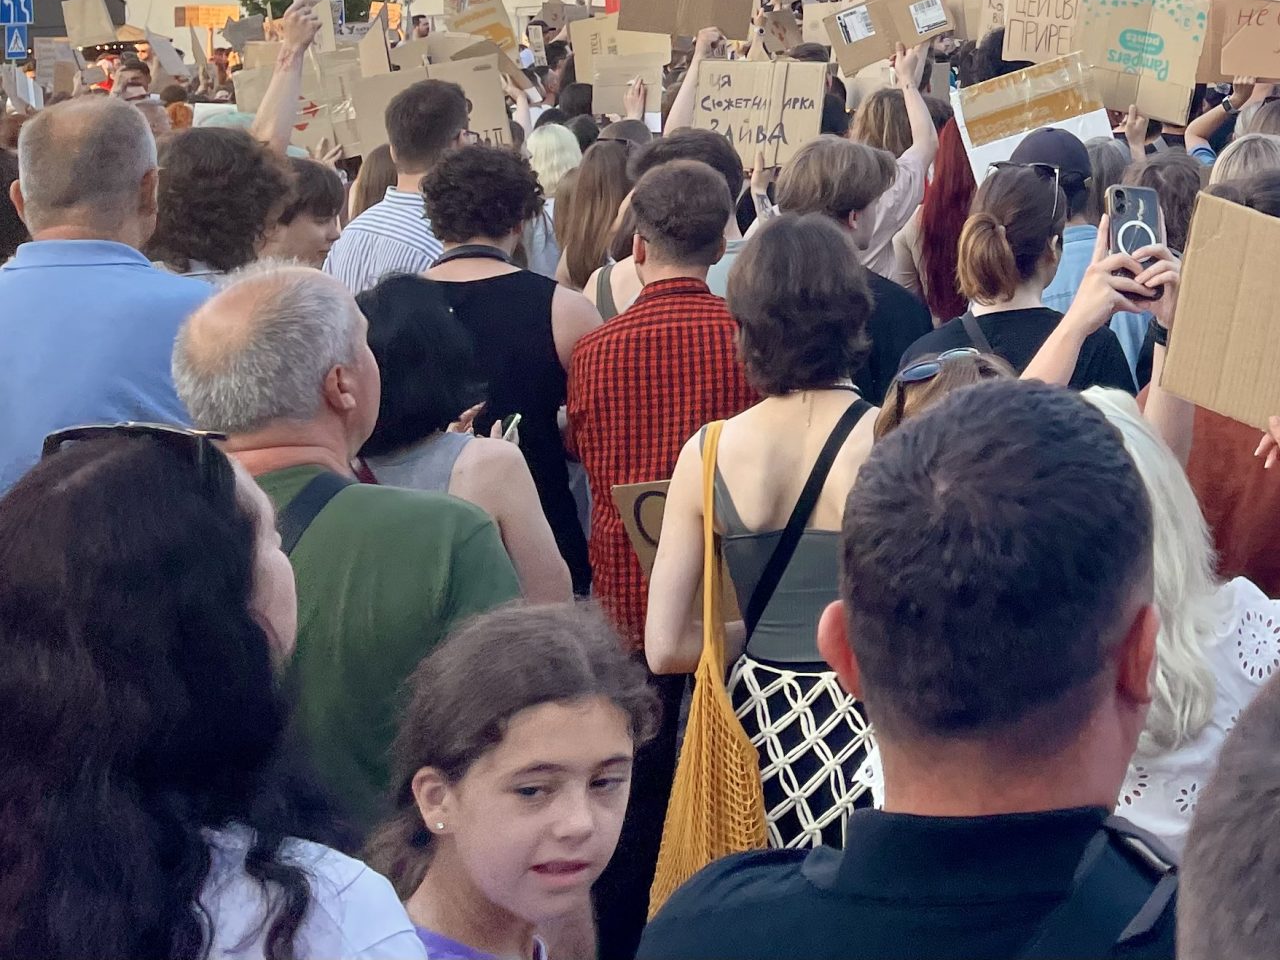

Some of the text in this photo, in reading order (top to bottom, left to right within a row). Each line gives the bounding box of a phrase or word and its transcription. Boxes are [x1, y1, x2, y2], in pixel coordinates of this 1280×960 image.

[1237, 8, 1269, 26] не
[1007, 18, 1073, 56] ПРИРЕ
[1107, 48, 1169, 82] Pampers
[710, 73, 732, 91] ЦЯ
[710, 118, 788, 146] ЗАЙВА
